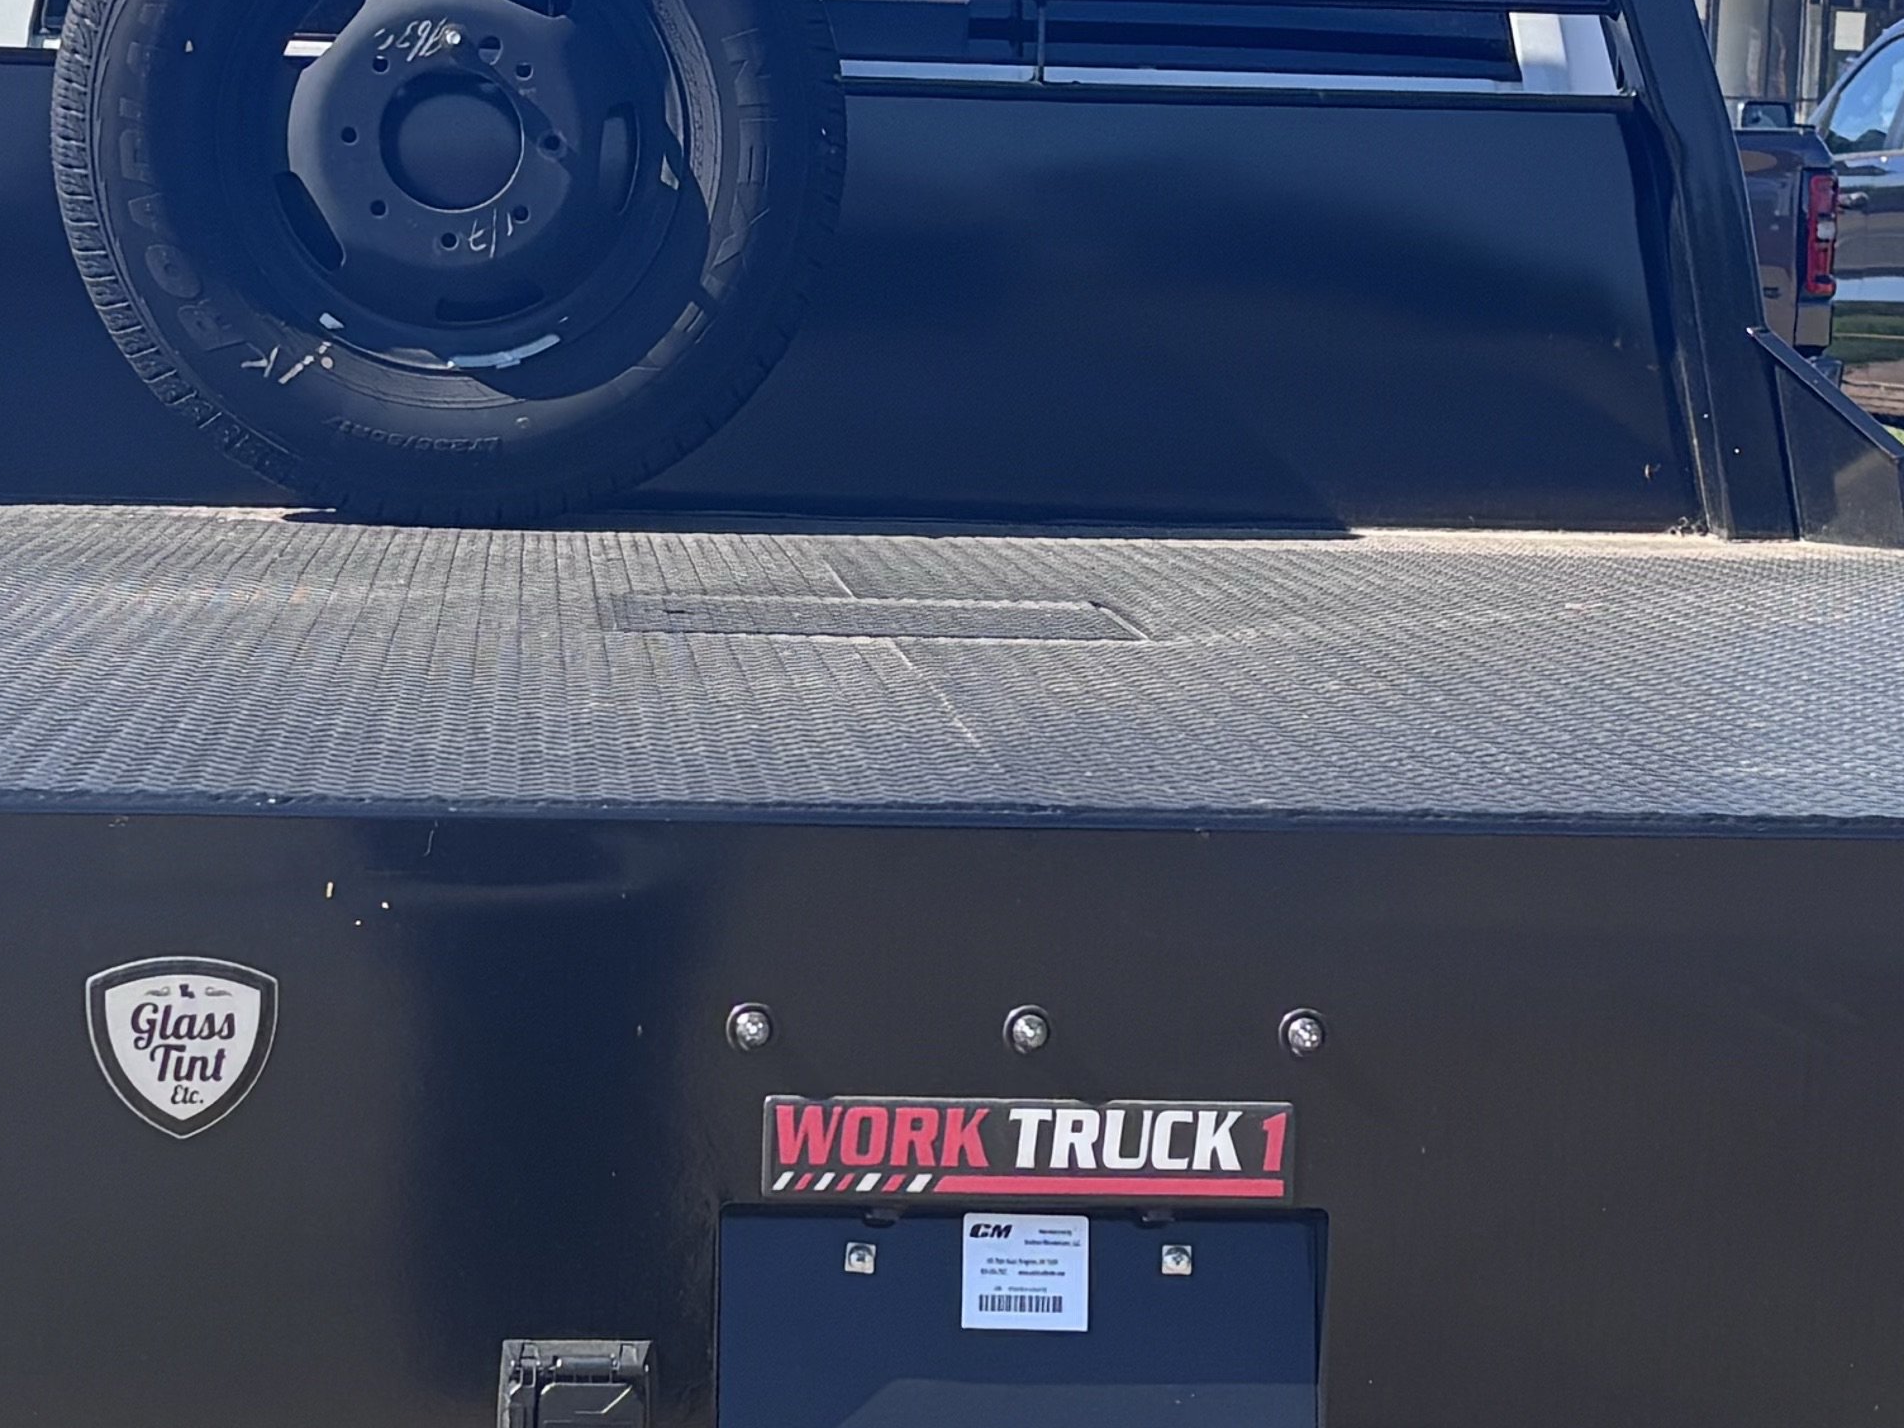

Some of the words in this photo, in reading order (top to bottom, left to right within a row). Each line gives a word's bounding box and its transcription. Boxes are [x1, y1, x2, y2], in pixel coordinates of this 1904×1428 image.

[131, 1002, 235, 1050] Glass
[150, 1044, 225, 1082] Tint
[171, 1085, 204, 1104] Etc.
[775, 1105, 991, 1167] WORK
[1008, 1108, 1243, 1171] TRUCK
[1262, 1112, 1287, 1172] 1
[969, 1223, 1013, 1239] CM
